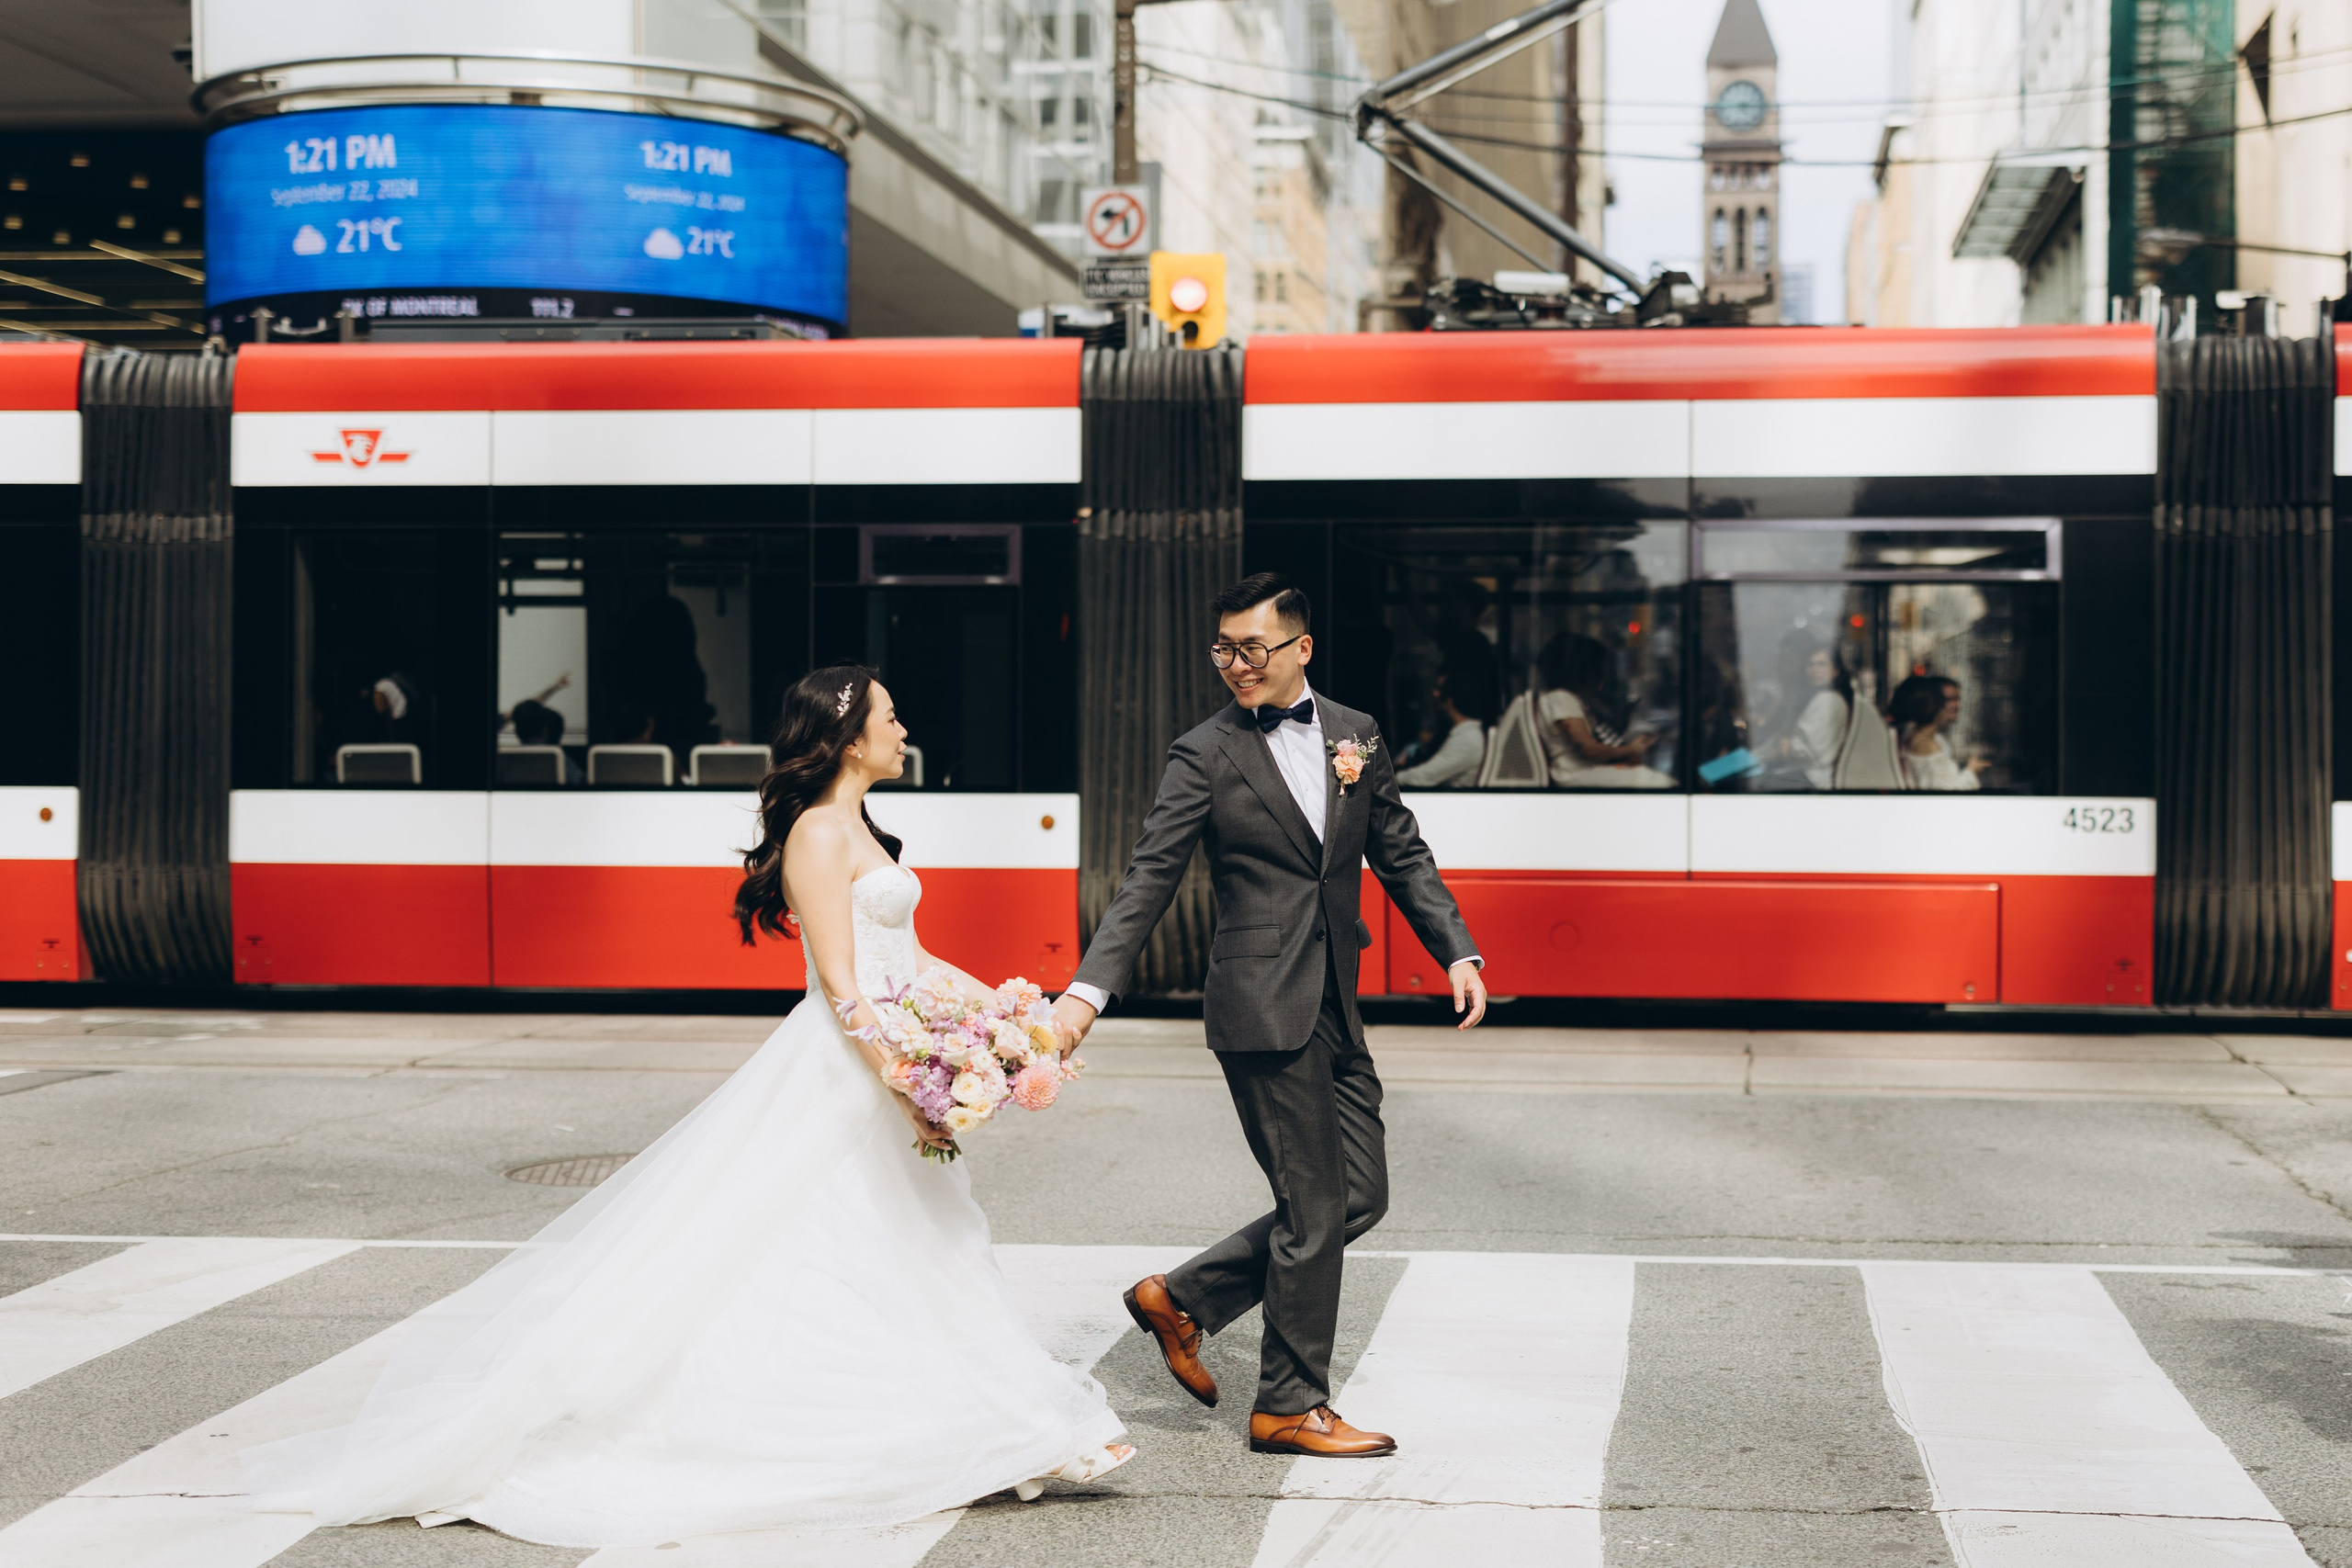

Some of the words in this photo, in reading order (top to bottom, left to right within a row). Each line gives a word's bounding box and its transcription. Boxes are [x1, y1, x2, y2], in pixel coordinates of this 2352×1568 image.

[285, 137, 337, 175] 1:21
[345, 133, 397, 170] PM
[640, 141, 689, 172] 1:21
[694, 145, 732, 177] PM
[271, 183, 345, 208] September
[336, 217, 402, 254] 21°C
[686, 226, 735, 258] 21°C
[390, 296, 481, 317] MONTREAL
[2064, 807, 2134, 833] 4523
